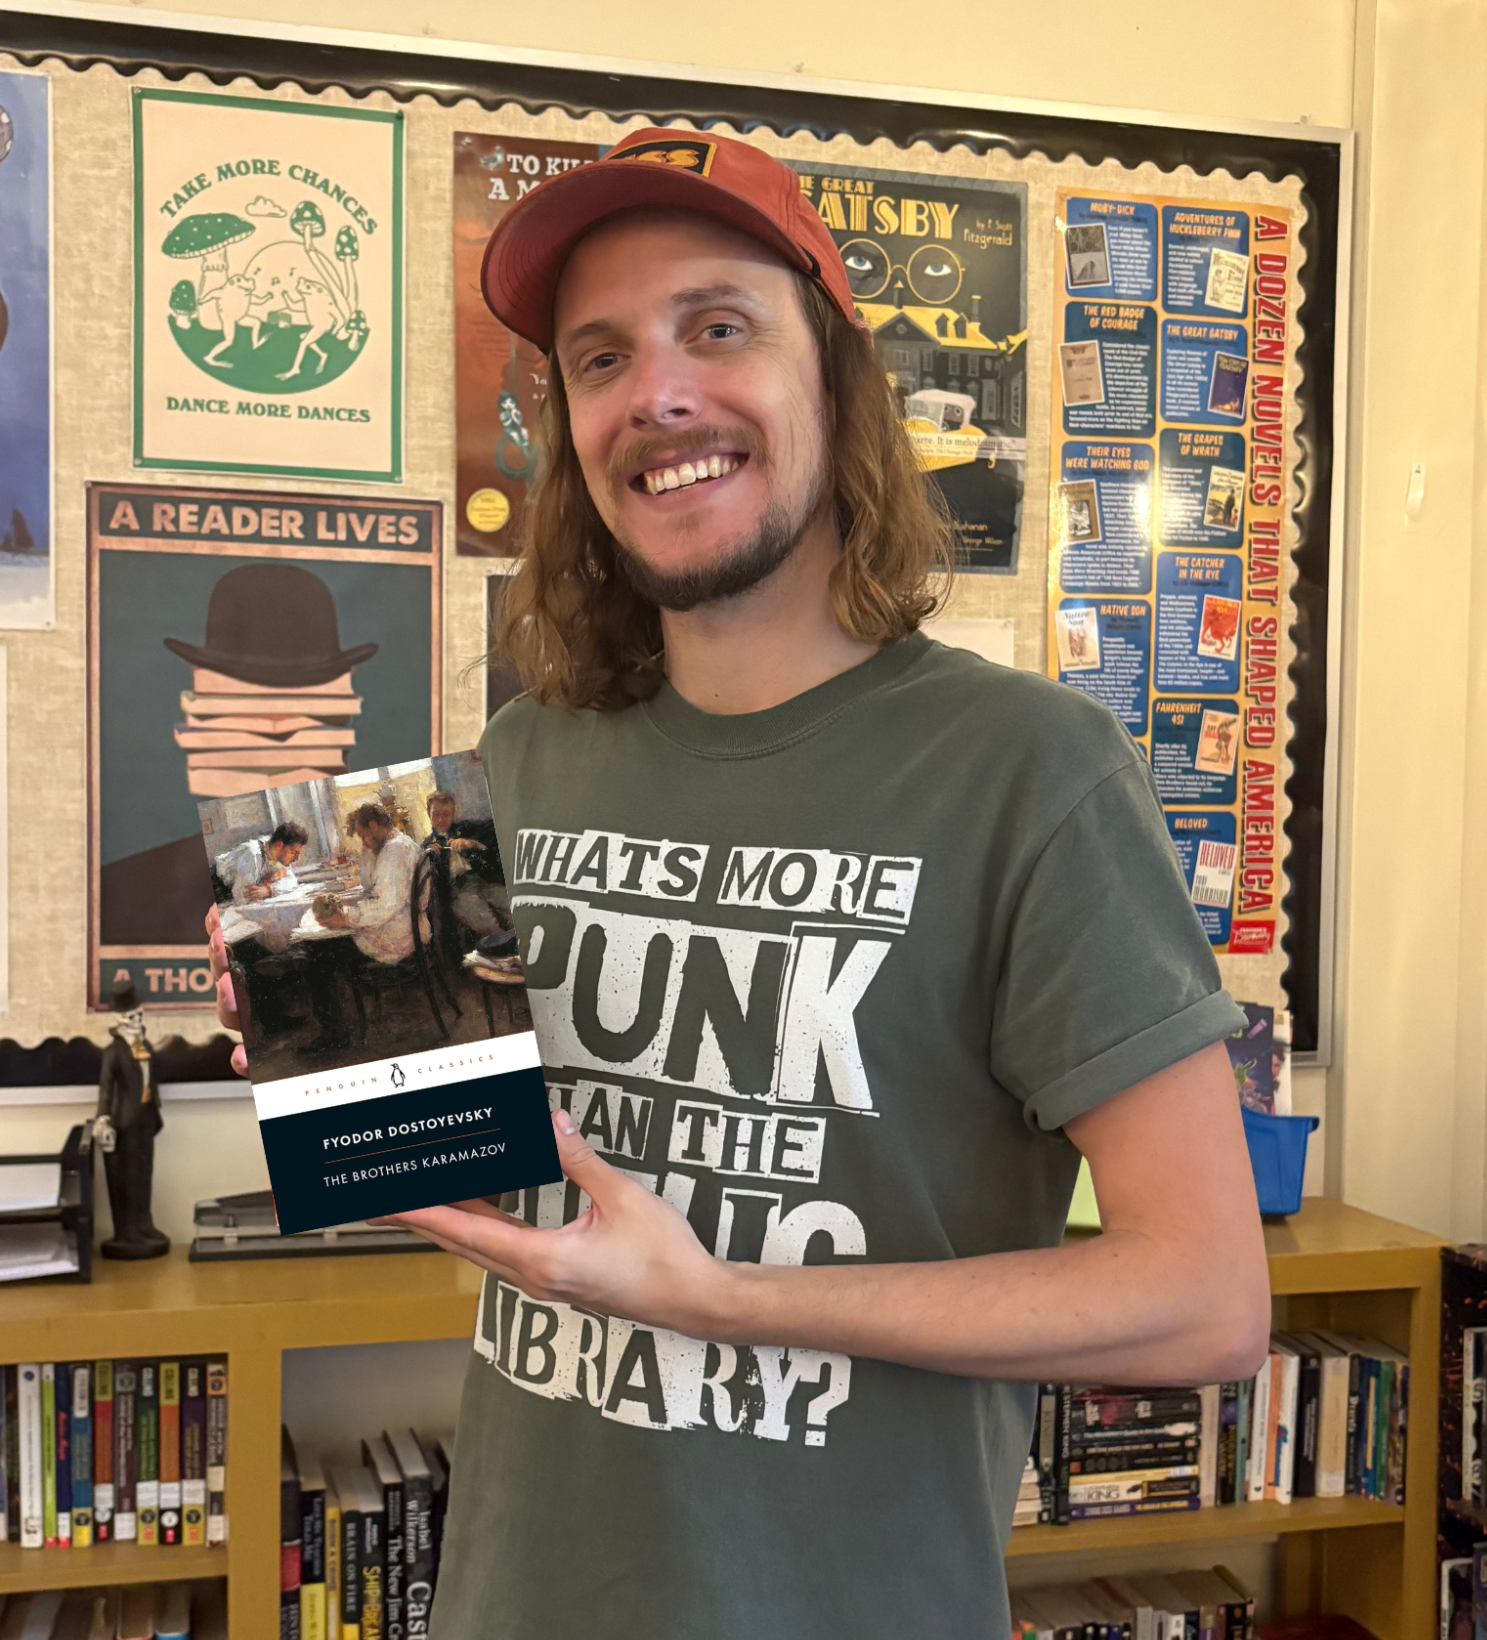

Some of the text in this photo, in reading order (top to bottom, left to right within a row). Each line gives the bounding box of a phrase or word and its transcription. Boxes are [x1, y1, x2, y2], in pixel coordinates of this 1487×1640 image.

[507, 154, 540, 175] TO
[160, 158, 378, 237] TAKE MORE CHANCES
[488, 178, 510, 200] A
[822, 177, 874, 194] GREAT
[800, 189, 959, 240] ATSBY
[1090, 202, 1135, 215] MOBY-DICK
[1174, 212, 1236, 226] ADVENTURES OF
[964, 228, 1012, 250] Fitzgerald
[1169, 224, 1241, 238] HUCKLEBERRY FINN
[1255, 214, 1288, 240] A
[1084, 305, 1145, 319] THE RED BADGE
[1254, 252, 1288, 365] DOZEN
[1089, 318, 1138, 330] OF COURAGE
[1167, 325, 1238, 341] THE GREAT GATSBY
[166, 396, 371, 423] DANCE MORE DANCES
[1087, 446, 1131, 458] THEIR EYES
[1178, 433, 1224, 445] THE GRAPES
[1181, 445, 1220, 457] OF WRATH
[1251, 373, 1285, 505] NOVELS
[1066, 458, 1149, 470] WERE WATCHING GOD
[110, 500, 419, 546] A READER LIVES
[1175, 557, 1225, 569] THE CATCHER
[1249, 517, 1281, 604] THAT
[1178, 569, 1220, 580] IN THE RYE
[1100, 604, 1146, 616] NATIVE SON
[1246, 615, 1279, 747] SHAPED
[1156, 702, 1202, 713] FAHRENHEIT
[1171, 714, 1184, 725] 451
[1174, 818, 1208, 829] BELOVED
[1242, 758, 1275, 911] AMERICA
[1199, 842, 1236, 870] BELOVED
[513, 829, 923, 925] WHATS MORE
[511, 897, 893, 1113] PUNK
[304, 1054, 494, 1096] PENGUIN CLASSICS
[323, 1107, 494, 1150] FYODOR DOSTOYEVSKY
[667, 1099, 827, 1185] THE
[323, 1142, 506, 1188] THE BROTHERS KARAMAZOV
[474, 1268, 852, 1447] LIBRARY?
[1061, 1434, 1070, 1459] KING
[1087, 1490, 1120, 1501] KING
[406, 1500, 419, 1564] Wilkerson
[418, 1510, 431, 1550] Isabel
[388, 1535, 403, 1562] The
[346, 1522, 356, 1612] BRAIN ON FIRE
[388, 1564, 402, 1594] New
[363, 1565, 382, 1598] SHIP
[386, 1598, 402, 1621] Jim
